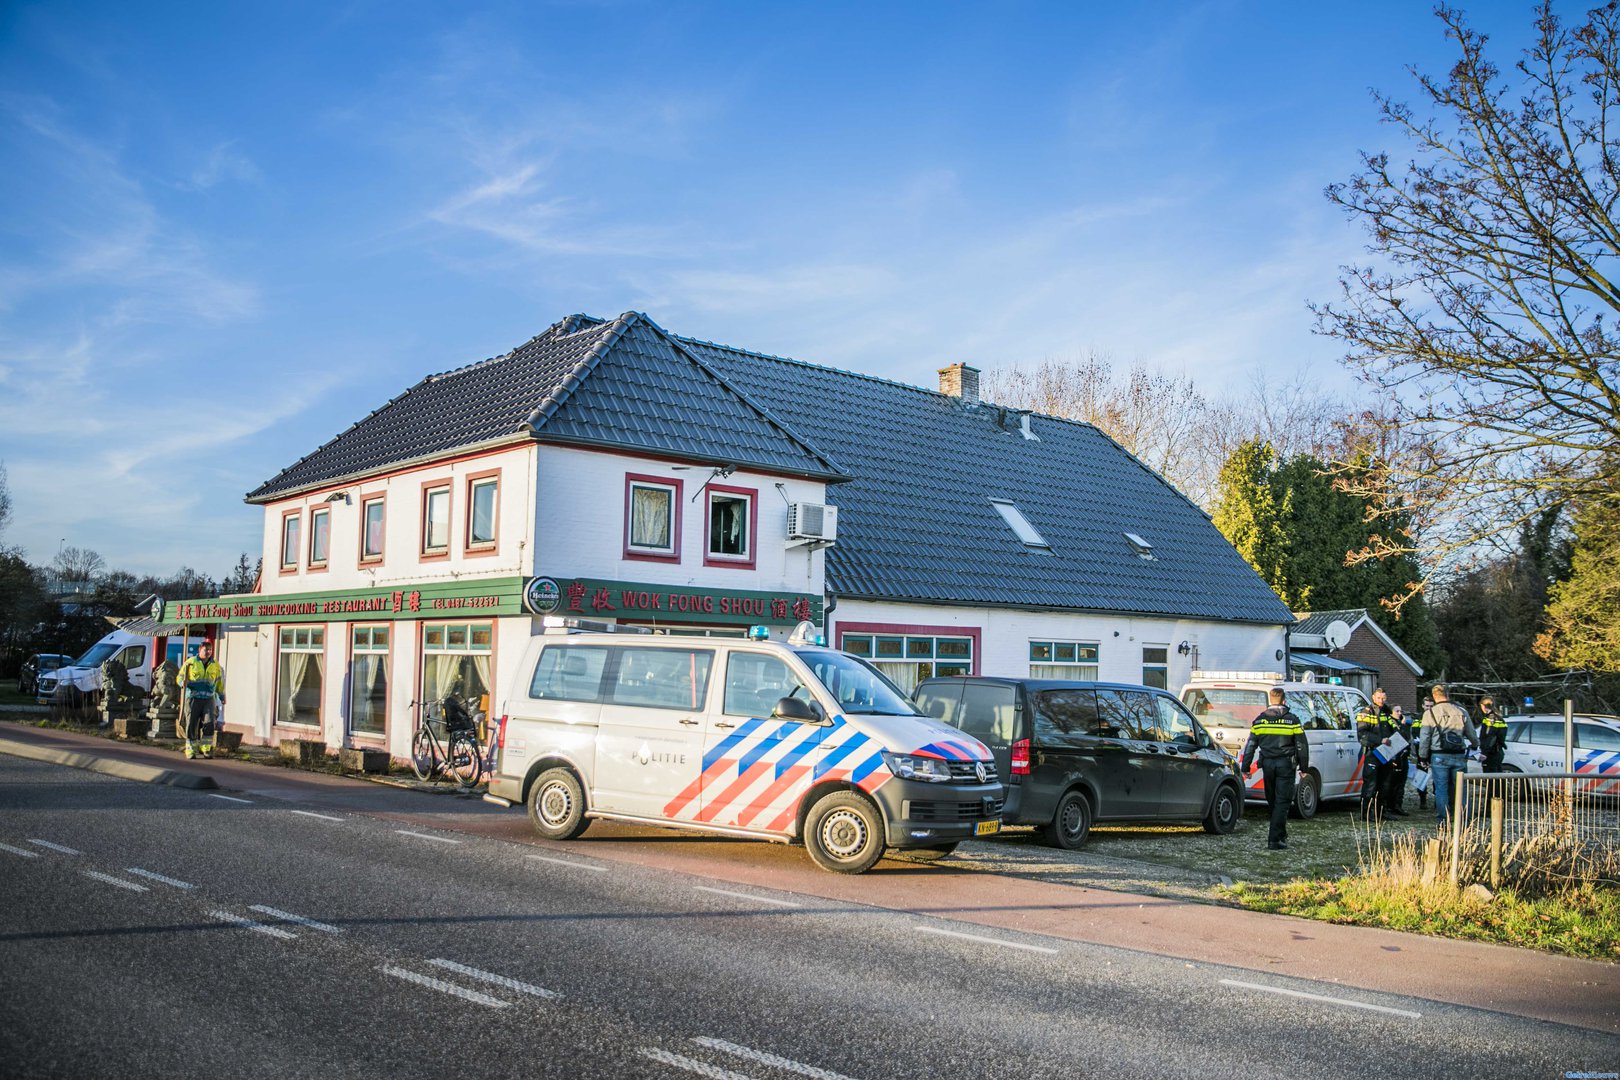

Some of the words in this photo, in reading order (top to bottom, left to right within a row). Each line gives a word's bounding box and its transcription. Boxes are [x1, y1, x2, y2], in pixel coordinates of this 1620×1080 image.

[195, 604, 210, 618] Wok
[211, 603, 231, 620] Fong
[233, 602, 253, 617] Shou
[257, 601, 317, 616] SHOWCOOKING
[323, 597, 388, 613] RESTAURANT
[621, 590, 661, 609] WOK
[669, 593, 714, 613] FONG
[720, 597, 764, 616] SHOU
[1532, 759, 1564, 769] POLITI
